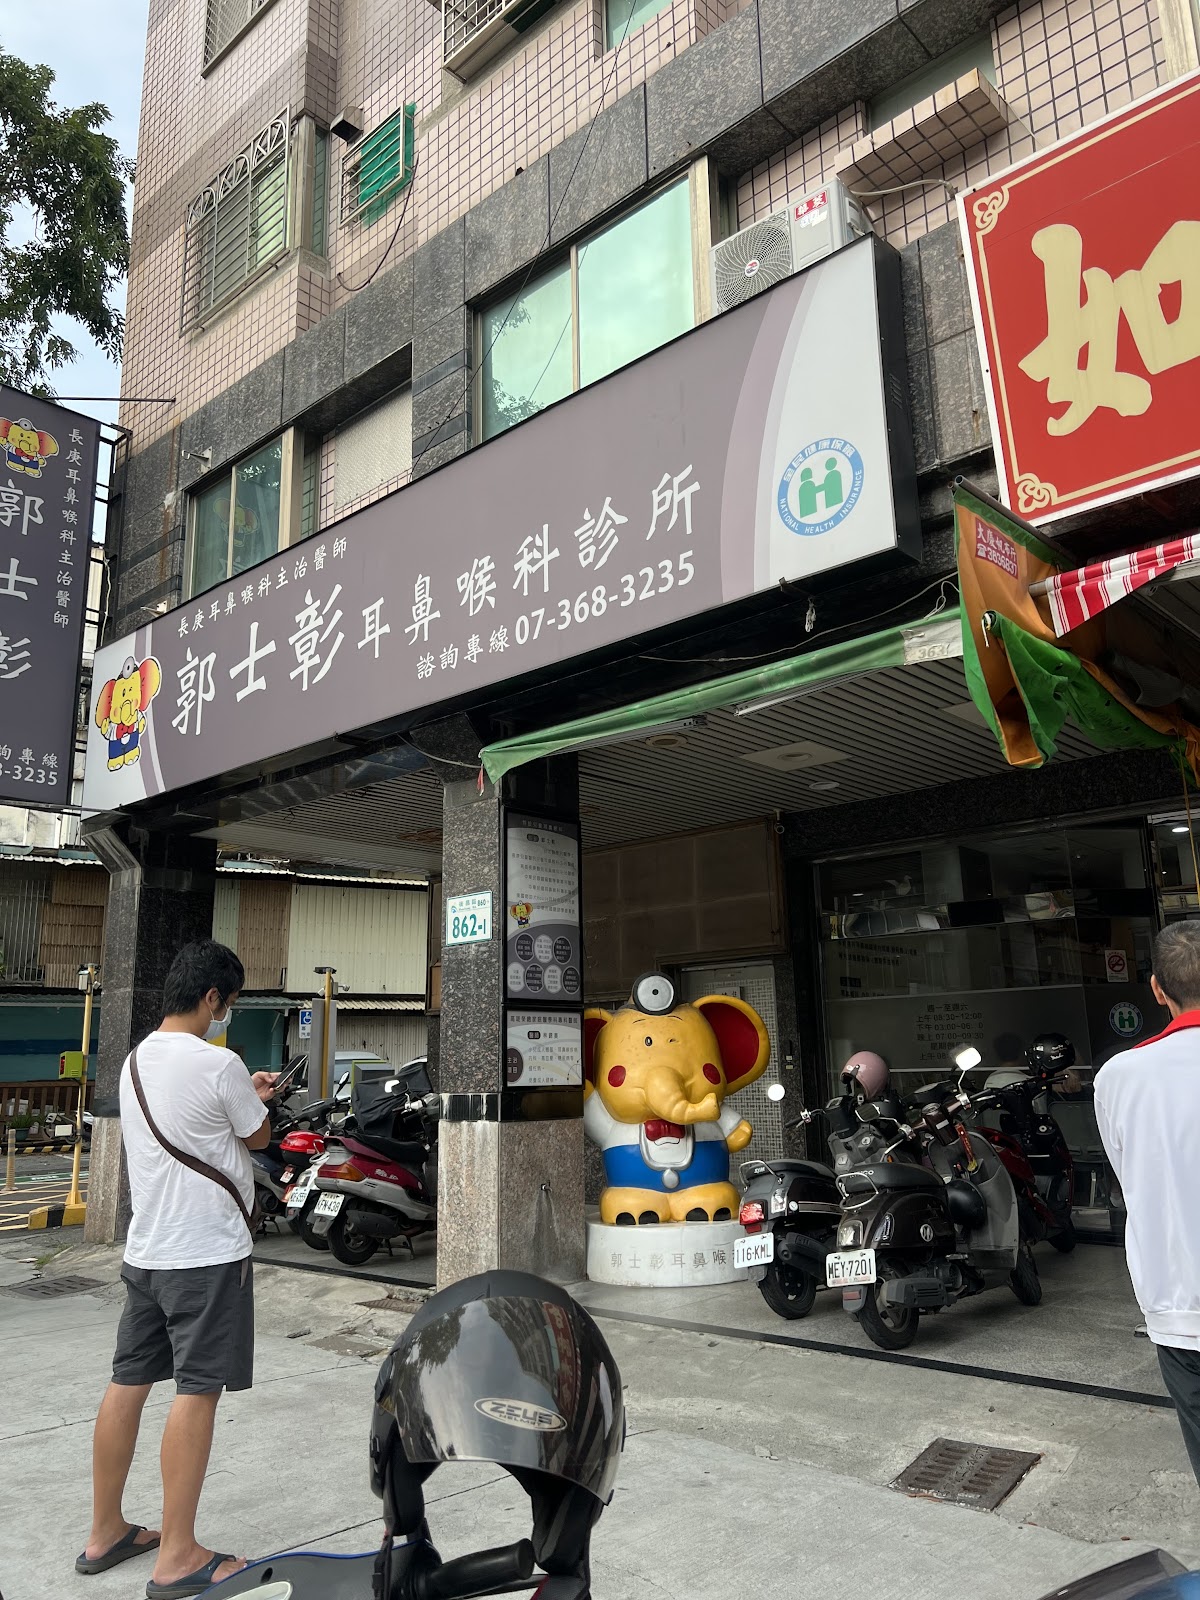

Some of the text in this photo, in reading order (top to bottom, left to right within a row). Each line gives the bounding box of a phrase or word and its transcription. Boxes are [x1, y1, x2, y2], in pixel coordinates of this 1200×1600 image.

[53, 428, 84, 628] 長庚耳鼻喉科主治醫師
[779, 469, 862, 534] NATIONAL HEALTH INSURANCE
[171, 464, 700, 735] 郭士彰耳鼻喉科診所
[177, 536, 347, 638] 長庚耳鼻喉科主治醫師
[416, 550, 695, 680] 諮詢專線 07-368-3235
[452, 913, 486, 939] 862-1
[610, 1249, 733, 1270] 郭士彰耳鼻喉
[490, 1402, 553, 1425] ZEUS
